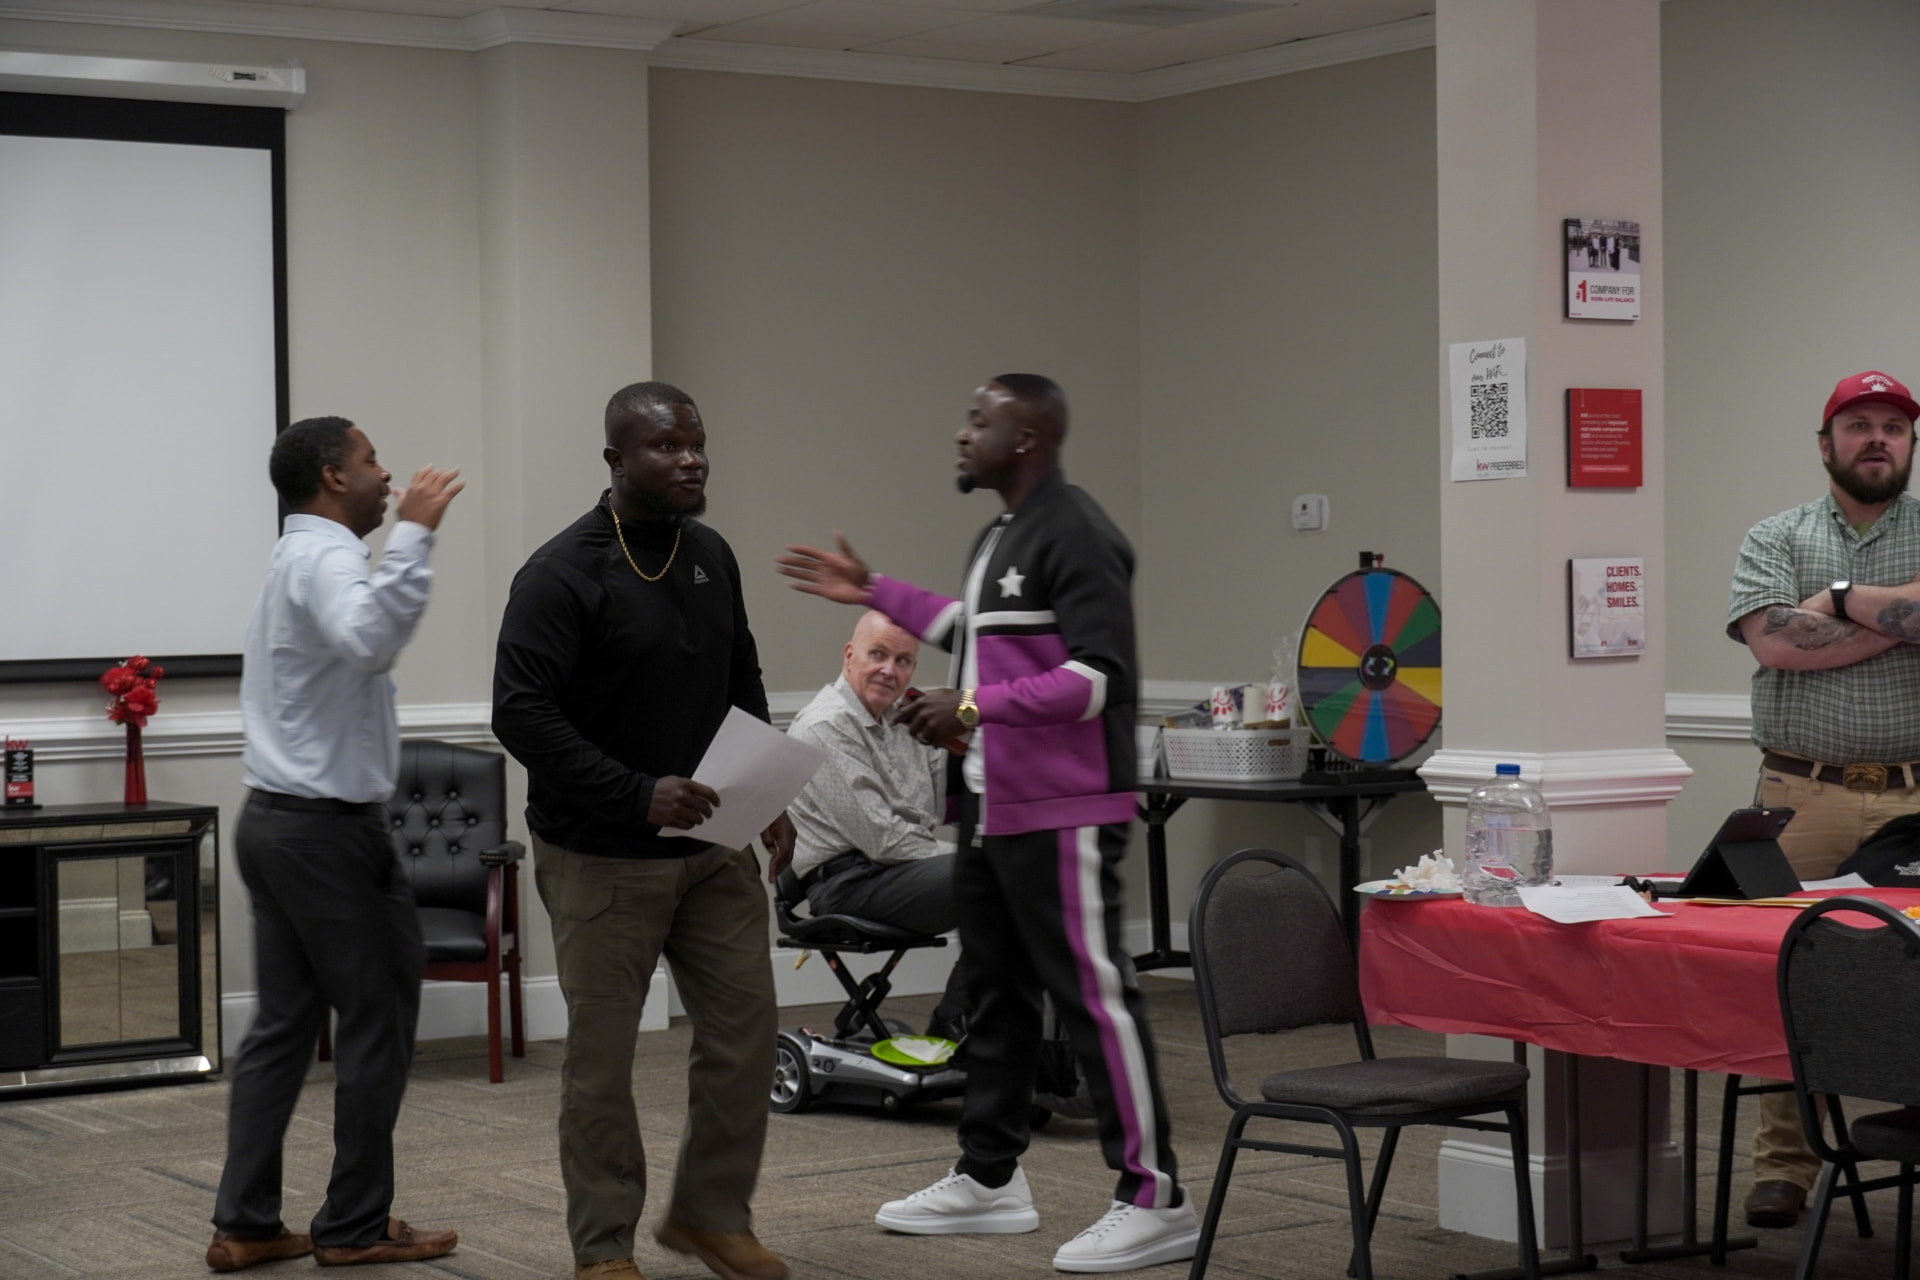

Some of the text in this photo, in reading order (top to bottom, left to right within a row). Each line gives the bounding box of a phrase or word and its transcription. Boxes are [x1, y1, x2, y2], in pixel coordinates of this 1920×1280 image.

[1576, 279, 1587, 303] #1
[1590, 285, 1635, 296] COMPANY FOR
[1498, 342, 1505, 358] to
[1476, 459, 1525, 472] kw PREFERRED
[1606, 566, 1642, 577] CLIENTS.
[1606, 581, 1638, 593] HOMES.
[1606, 596, 1640, 608] SMILES.
[5, 735, 29, 751] kw
